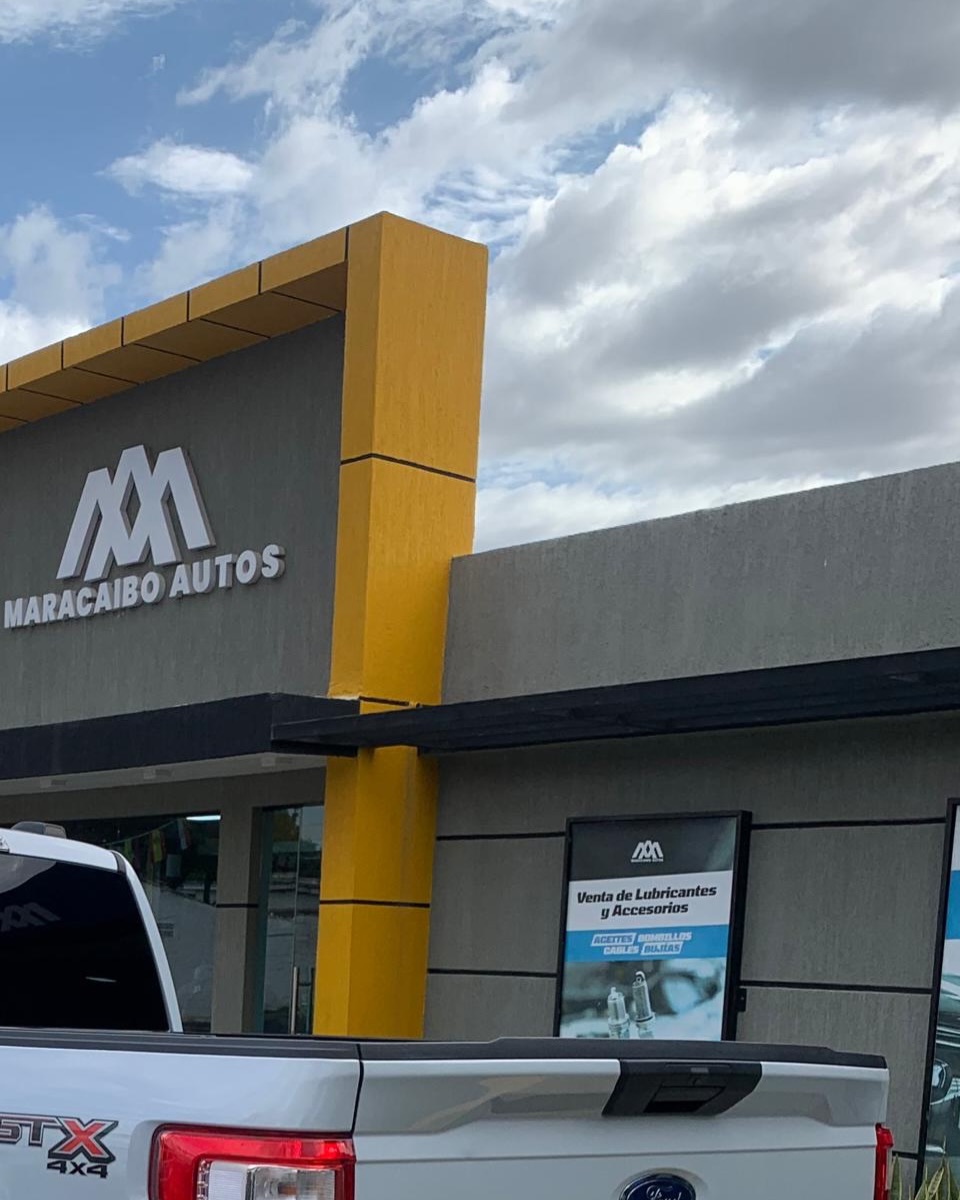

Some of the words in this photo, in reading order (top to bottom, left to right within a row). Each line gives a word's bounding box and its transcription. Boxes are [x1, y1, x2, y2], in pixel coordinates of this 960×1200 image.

[4, 571, 164, 628] MARACAIBO
[169, 544, 284, 598] AUTOS
[577, 891, 614, 904] Venta
[616, 889, 633, 901] de
[635, 885, 717, 901] Lubricantes
[600, 908, 610, 919] y
[612, 902, 689, 917] Accesorios
[594, 934, 633, 945] ACEITES
